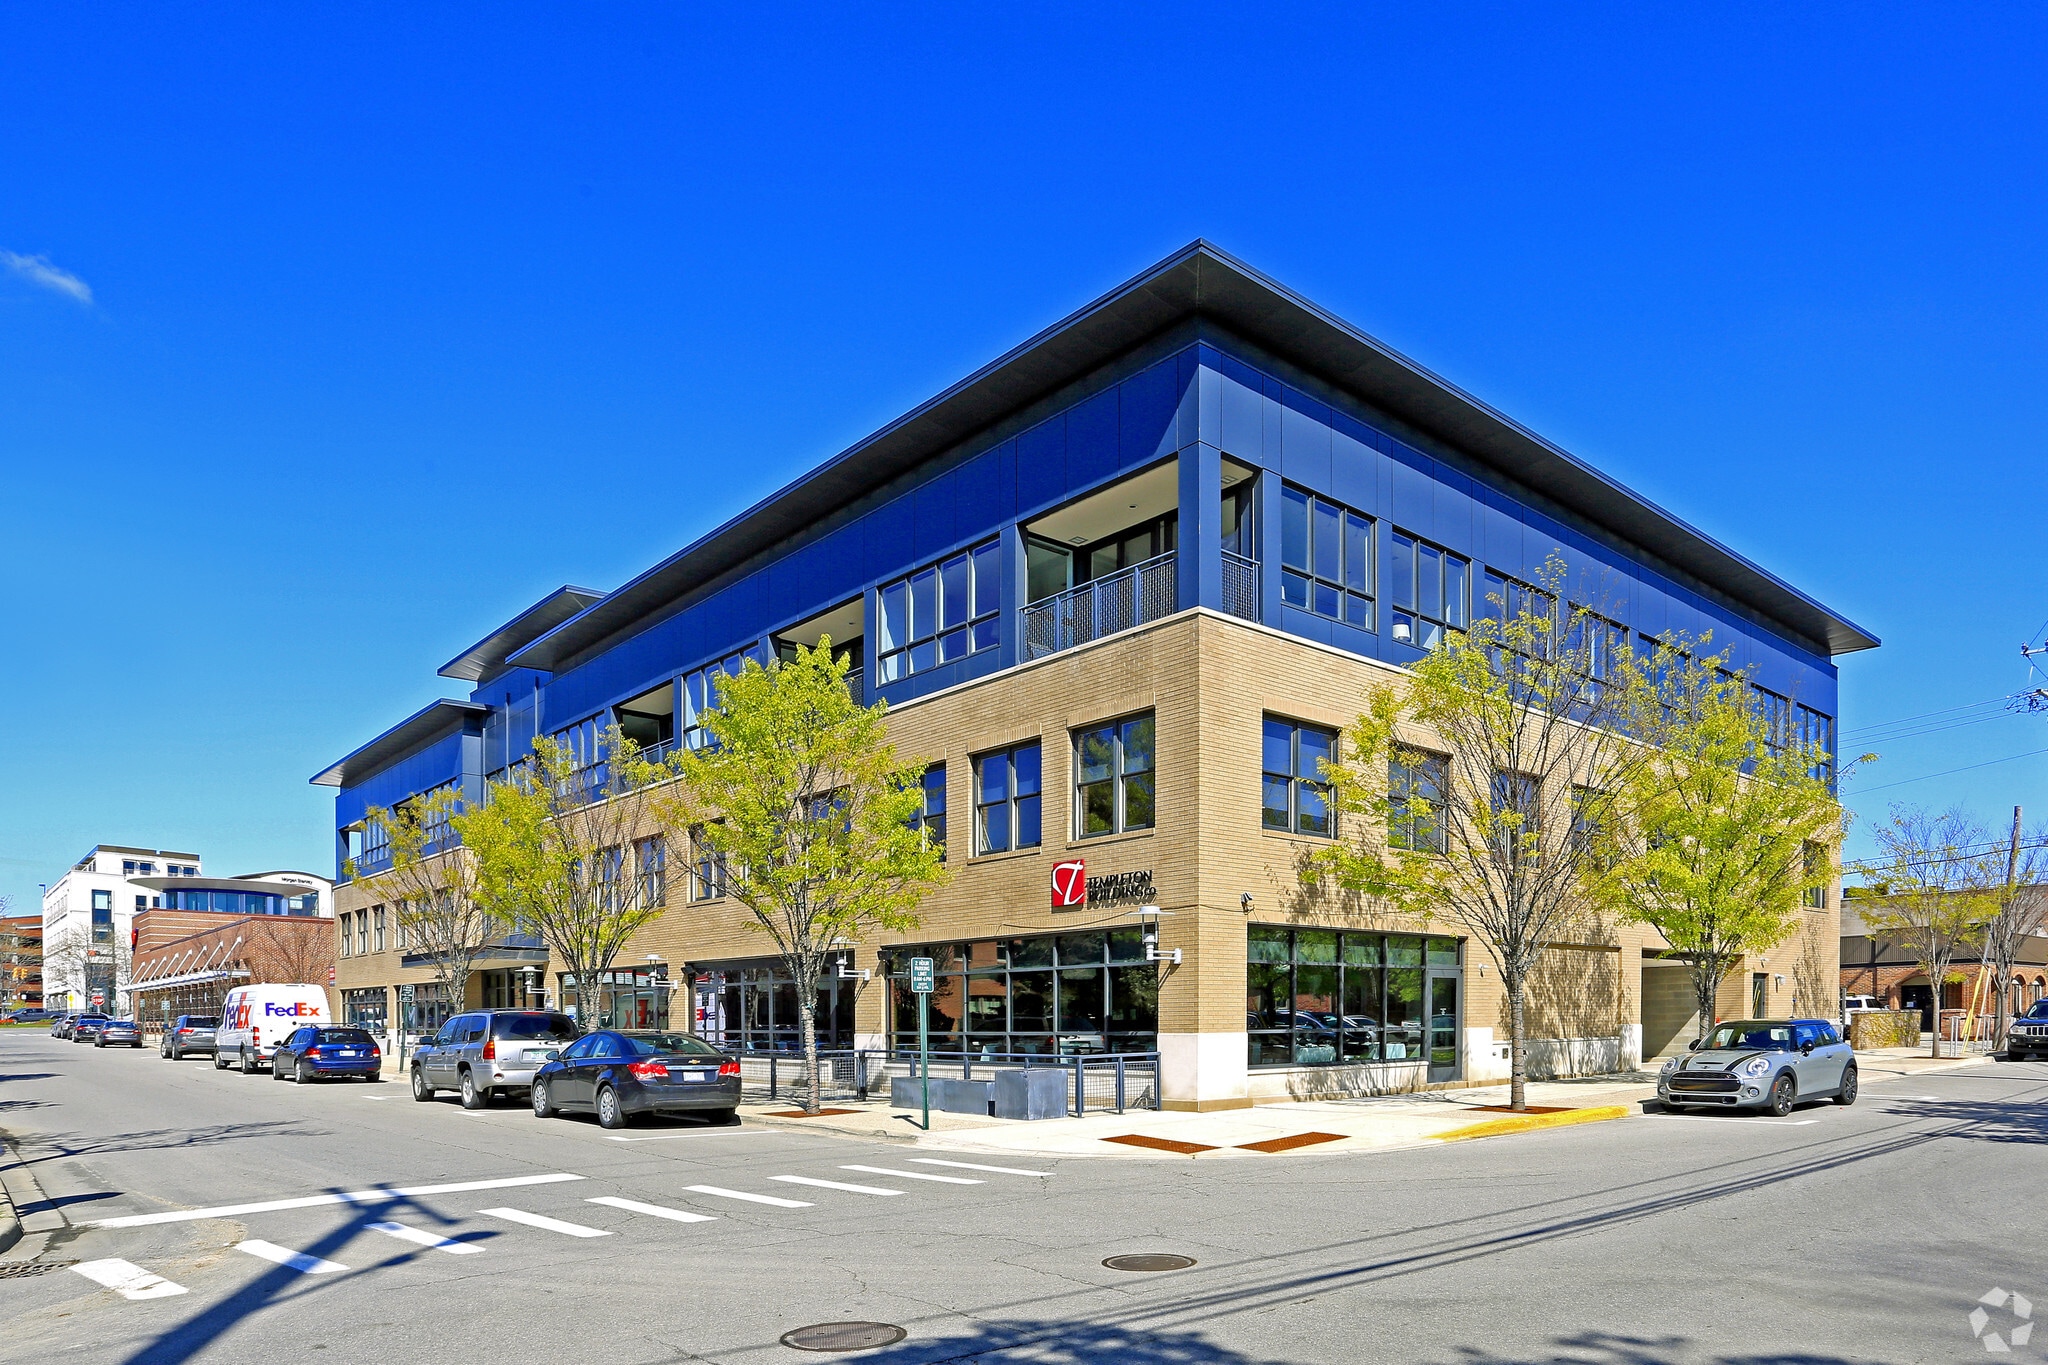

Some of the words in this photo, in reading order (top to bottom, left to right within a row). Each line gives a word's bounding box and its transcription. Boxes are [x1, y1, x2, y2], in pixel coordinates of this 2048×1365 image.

[1087, 870, 1152, 888] TEMPLETON
[1088, 885, 1143, 902] BUILDING
[225, 992, 251, 1030] FedEx
[265, 1003, 320, 1016] FedEx
